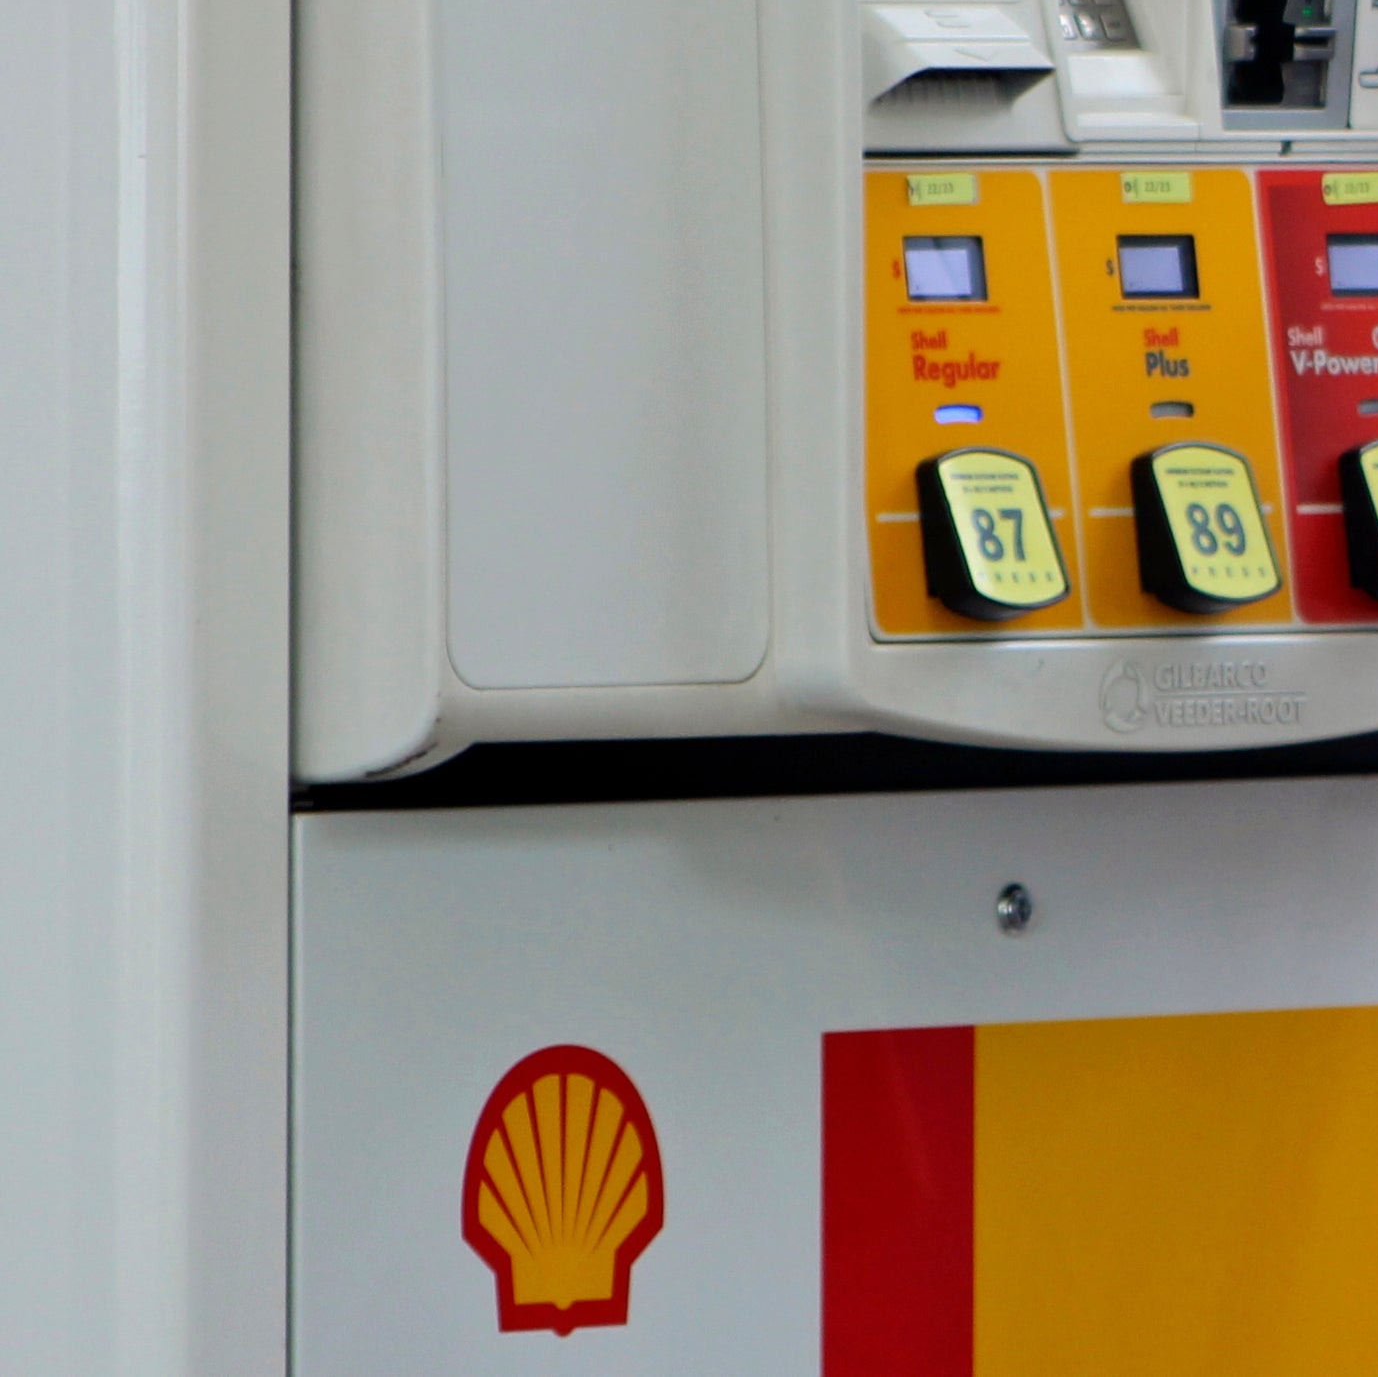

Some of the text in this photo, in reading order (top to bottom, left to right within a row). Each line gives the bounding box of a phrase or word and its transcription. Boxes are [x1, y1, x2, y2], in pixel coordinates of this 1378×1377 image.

[911, 329, 948, 350] Shell
[1143, 327, 1179, 348] Shell
[1287, 325, 1324, 347] Shell
[912, 351, 1001, 389] Regular
[1145, 349, 1190, 378] Plus
[970, 507, 1027, 562] 87
[1186, 501, 1247, 556] 89
[1153, 659, 1268, 692] GILBARCO
[1153, 696, 1308, 728] VEEDER-ROOT
